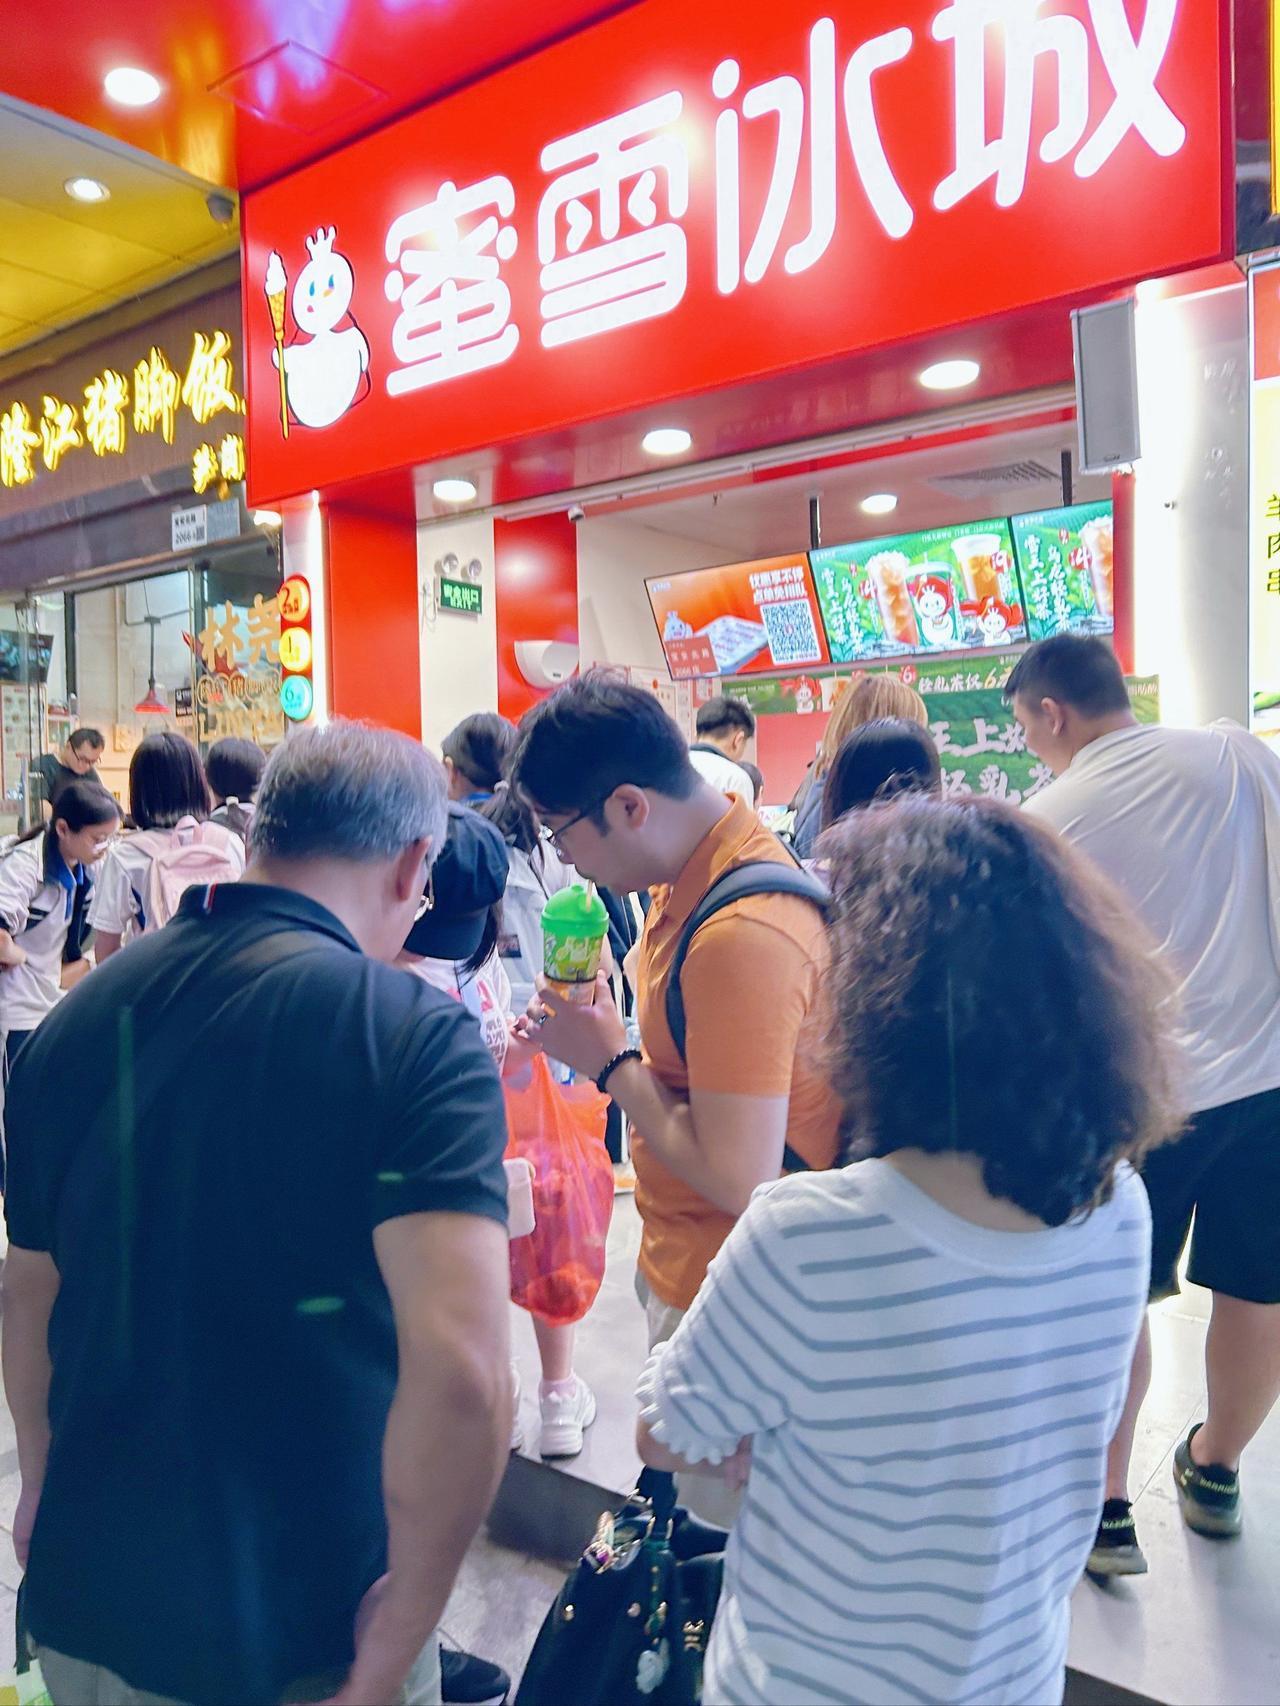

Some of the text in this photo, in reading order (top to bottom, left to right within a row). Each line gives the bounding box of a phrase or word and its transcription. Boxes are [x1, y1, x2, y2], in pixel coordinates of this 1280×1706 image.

[385, 0, 1187, 396] 蜜雪冰城
[1, 329, 241, 487] 隆江猪脚饭
